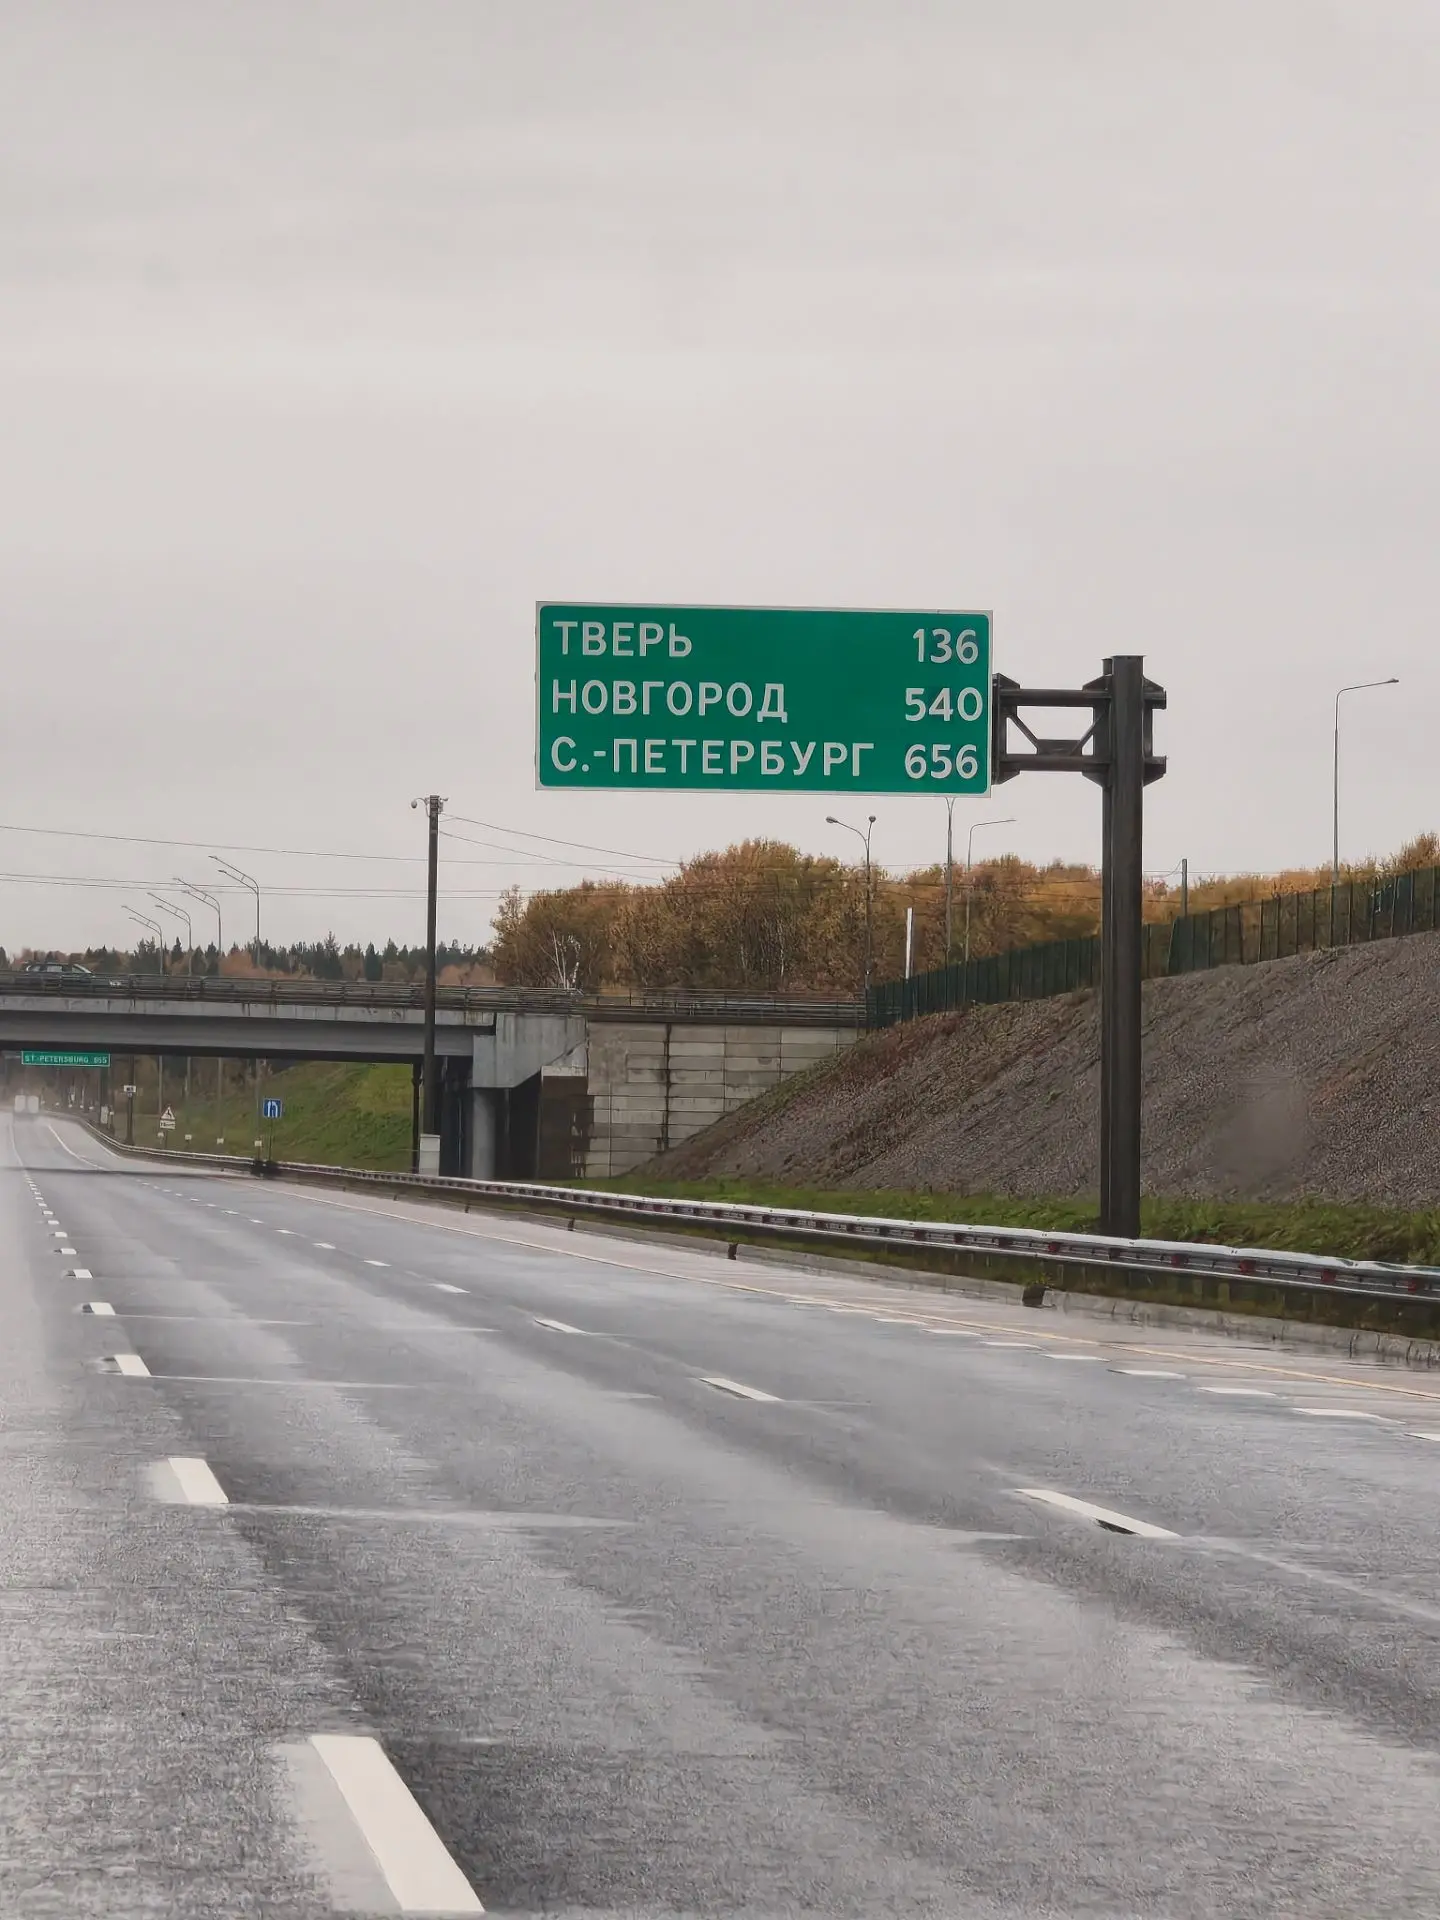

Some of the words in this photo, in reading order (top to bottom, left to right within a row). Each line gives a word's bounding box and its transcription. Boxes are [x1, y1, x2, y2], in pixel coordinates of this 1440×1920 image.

[552, 620, 692, 657] ТВЕРЬ
[913, 628, 979, 664] 136
[552, 679, 788, 723] НОВГОРОД
[905, 687, 983, 722] 540
[551, 736, 874, 777] С.-ПЕТЕРБУРГ
[904, 744, 978, 779] 656
